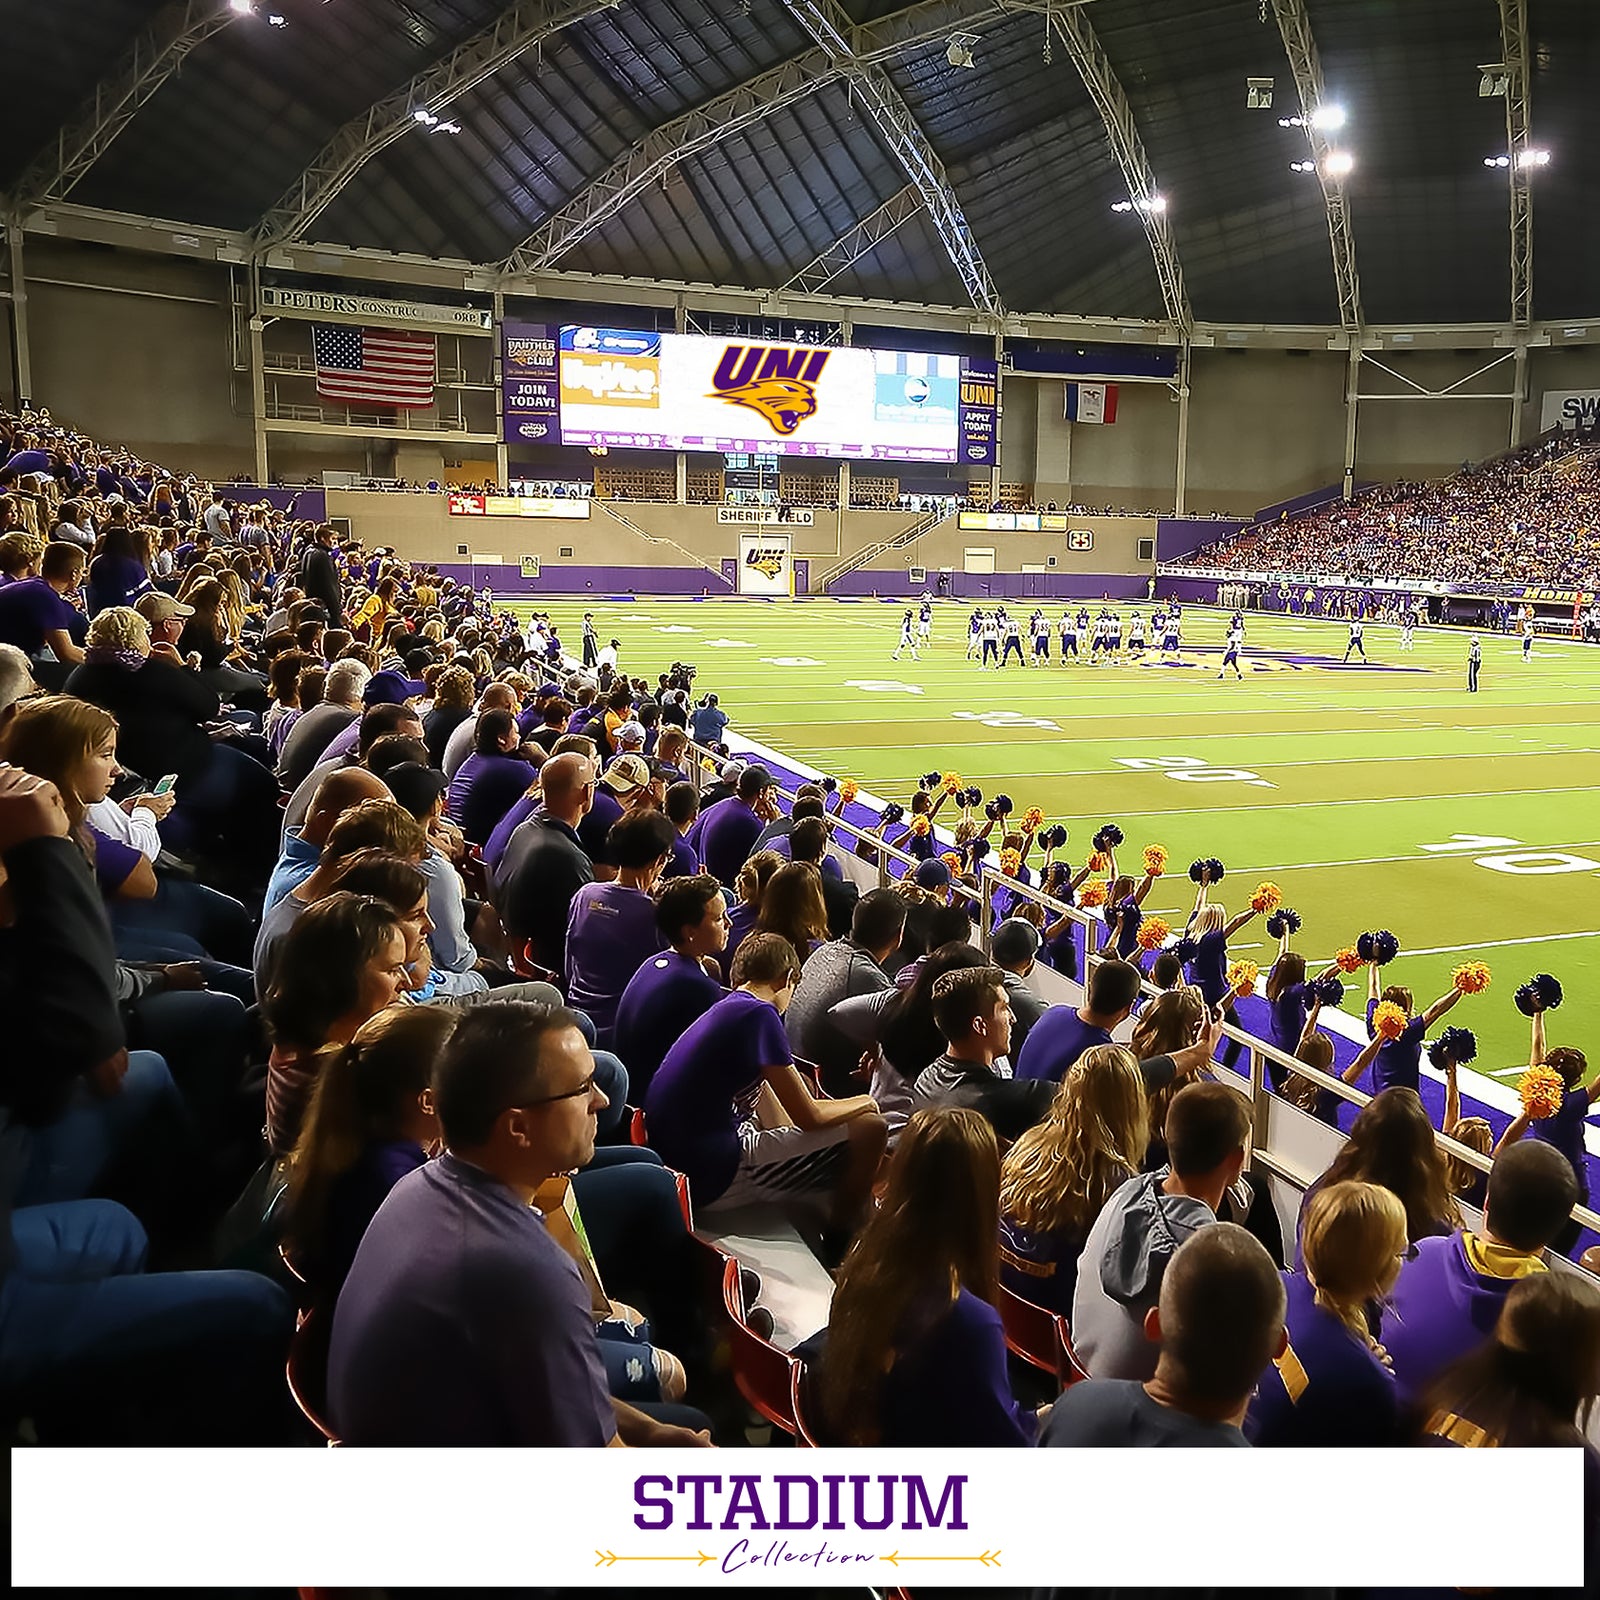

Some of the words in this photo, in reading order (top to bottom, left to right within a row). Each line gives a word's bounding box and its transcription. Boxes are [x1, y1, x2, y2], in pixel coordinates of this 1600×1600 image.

[279, 291, 357, 313] PETERS
[712, 345, 832, 391] UNI
[517, 384, 548, 396] JOIN
[960, 383, 995, 406] UNI
[509, 395, 556, 408] TODAY!
[965, 412, 991, 423] APPLY
[963, 421, 992, 433] TODAY!
[720, 510, 772, 522] SHERIFF
[1415, 833, 1600, 869] 10
